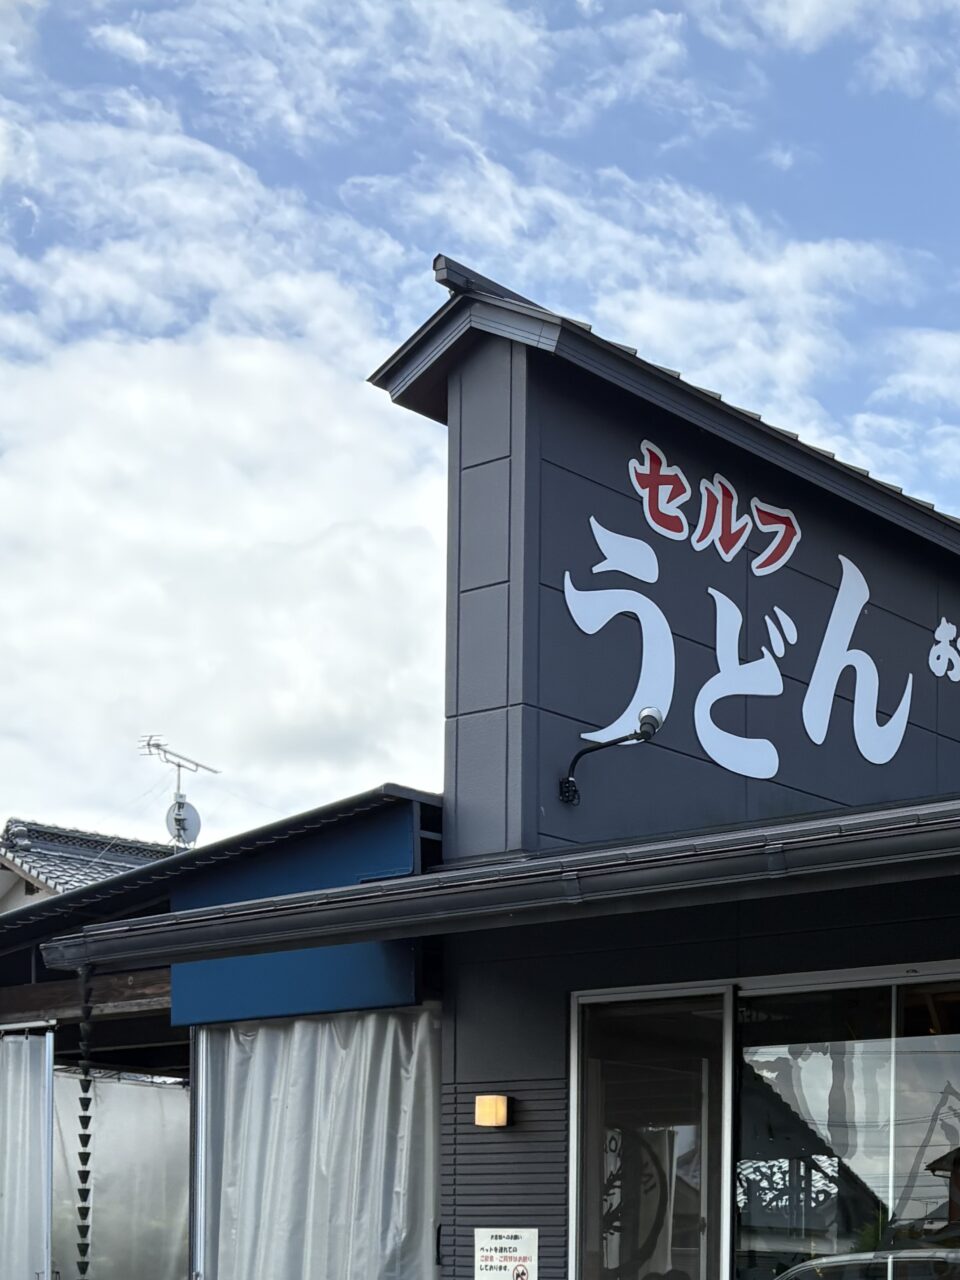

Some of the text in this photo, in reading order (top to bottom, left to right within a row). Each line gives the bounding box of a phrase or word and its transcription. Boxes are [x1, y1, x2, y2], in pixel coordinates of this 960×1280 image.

[629, 439, 800, 576] セルフ
[563, 515, 914, 780] うどん
